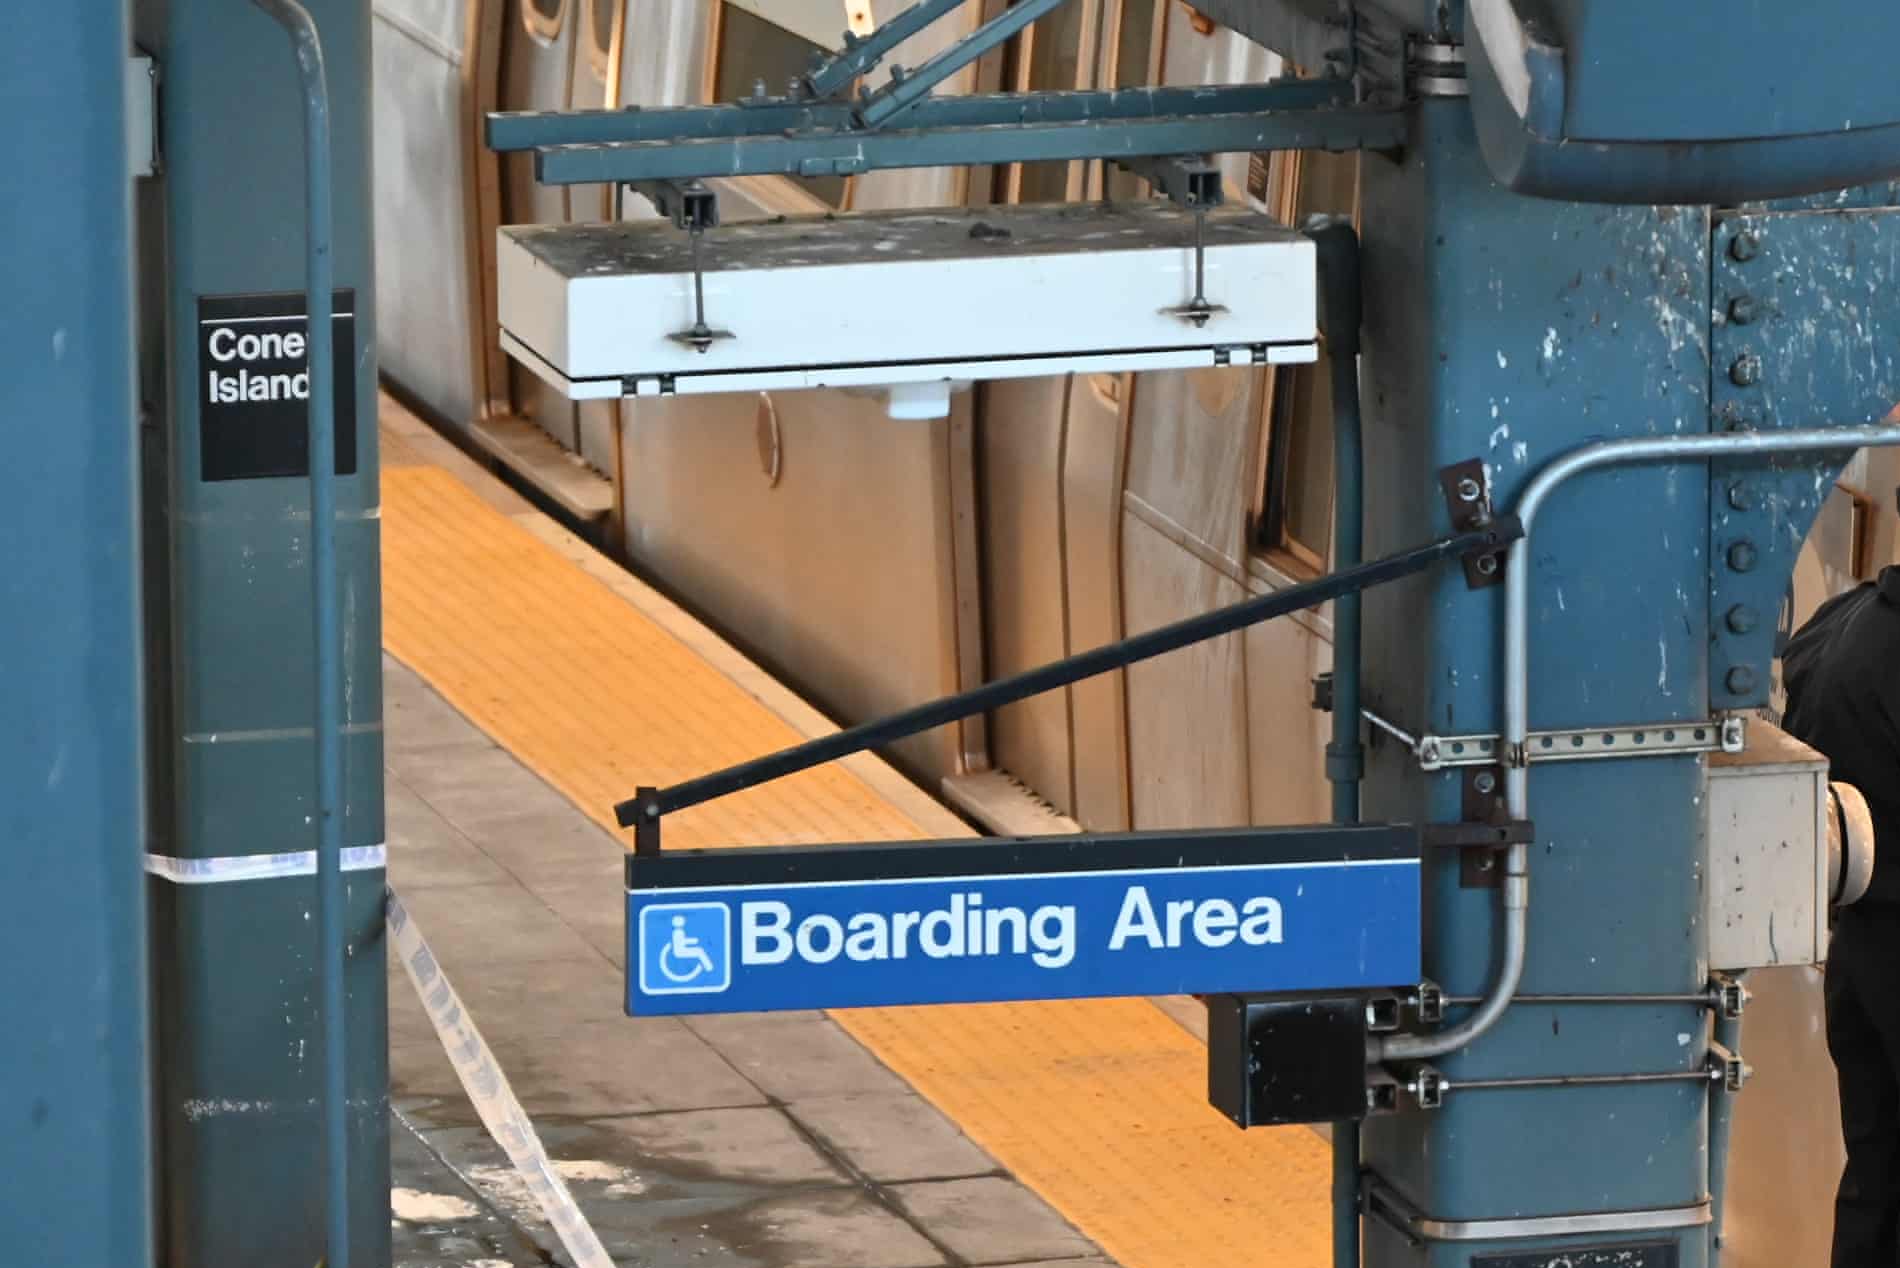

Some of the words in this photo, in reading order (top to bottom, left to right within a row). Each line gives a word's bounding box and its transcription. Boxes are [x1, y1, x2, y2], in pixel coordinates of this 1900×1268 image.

[208, 327, 309, 362] Cone
[209, 368, 310, 404] Island
[740, 890, 1078, 968] Boarding
[1108, 884, 1285, 951] Area
